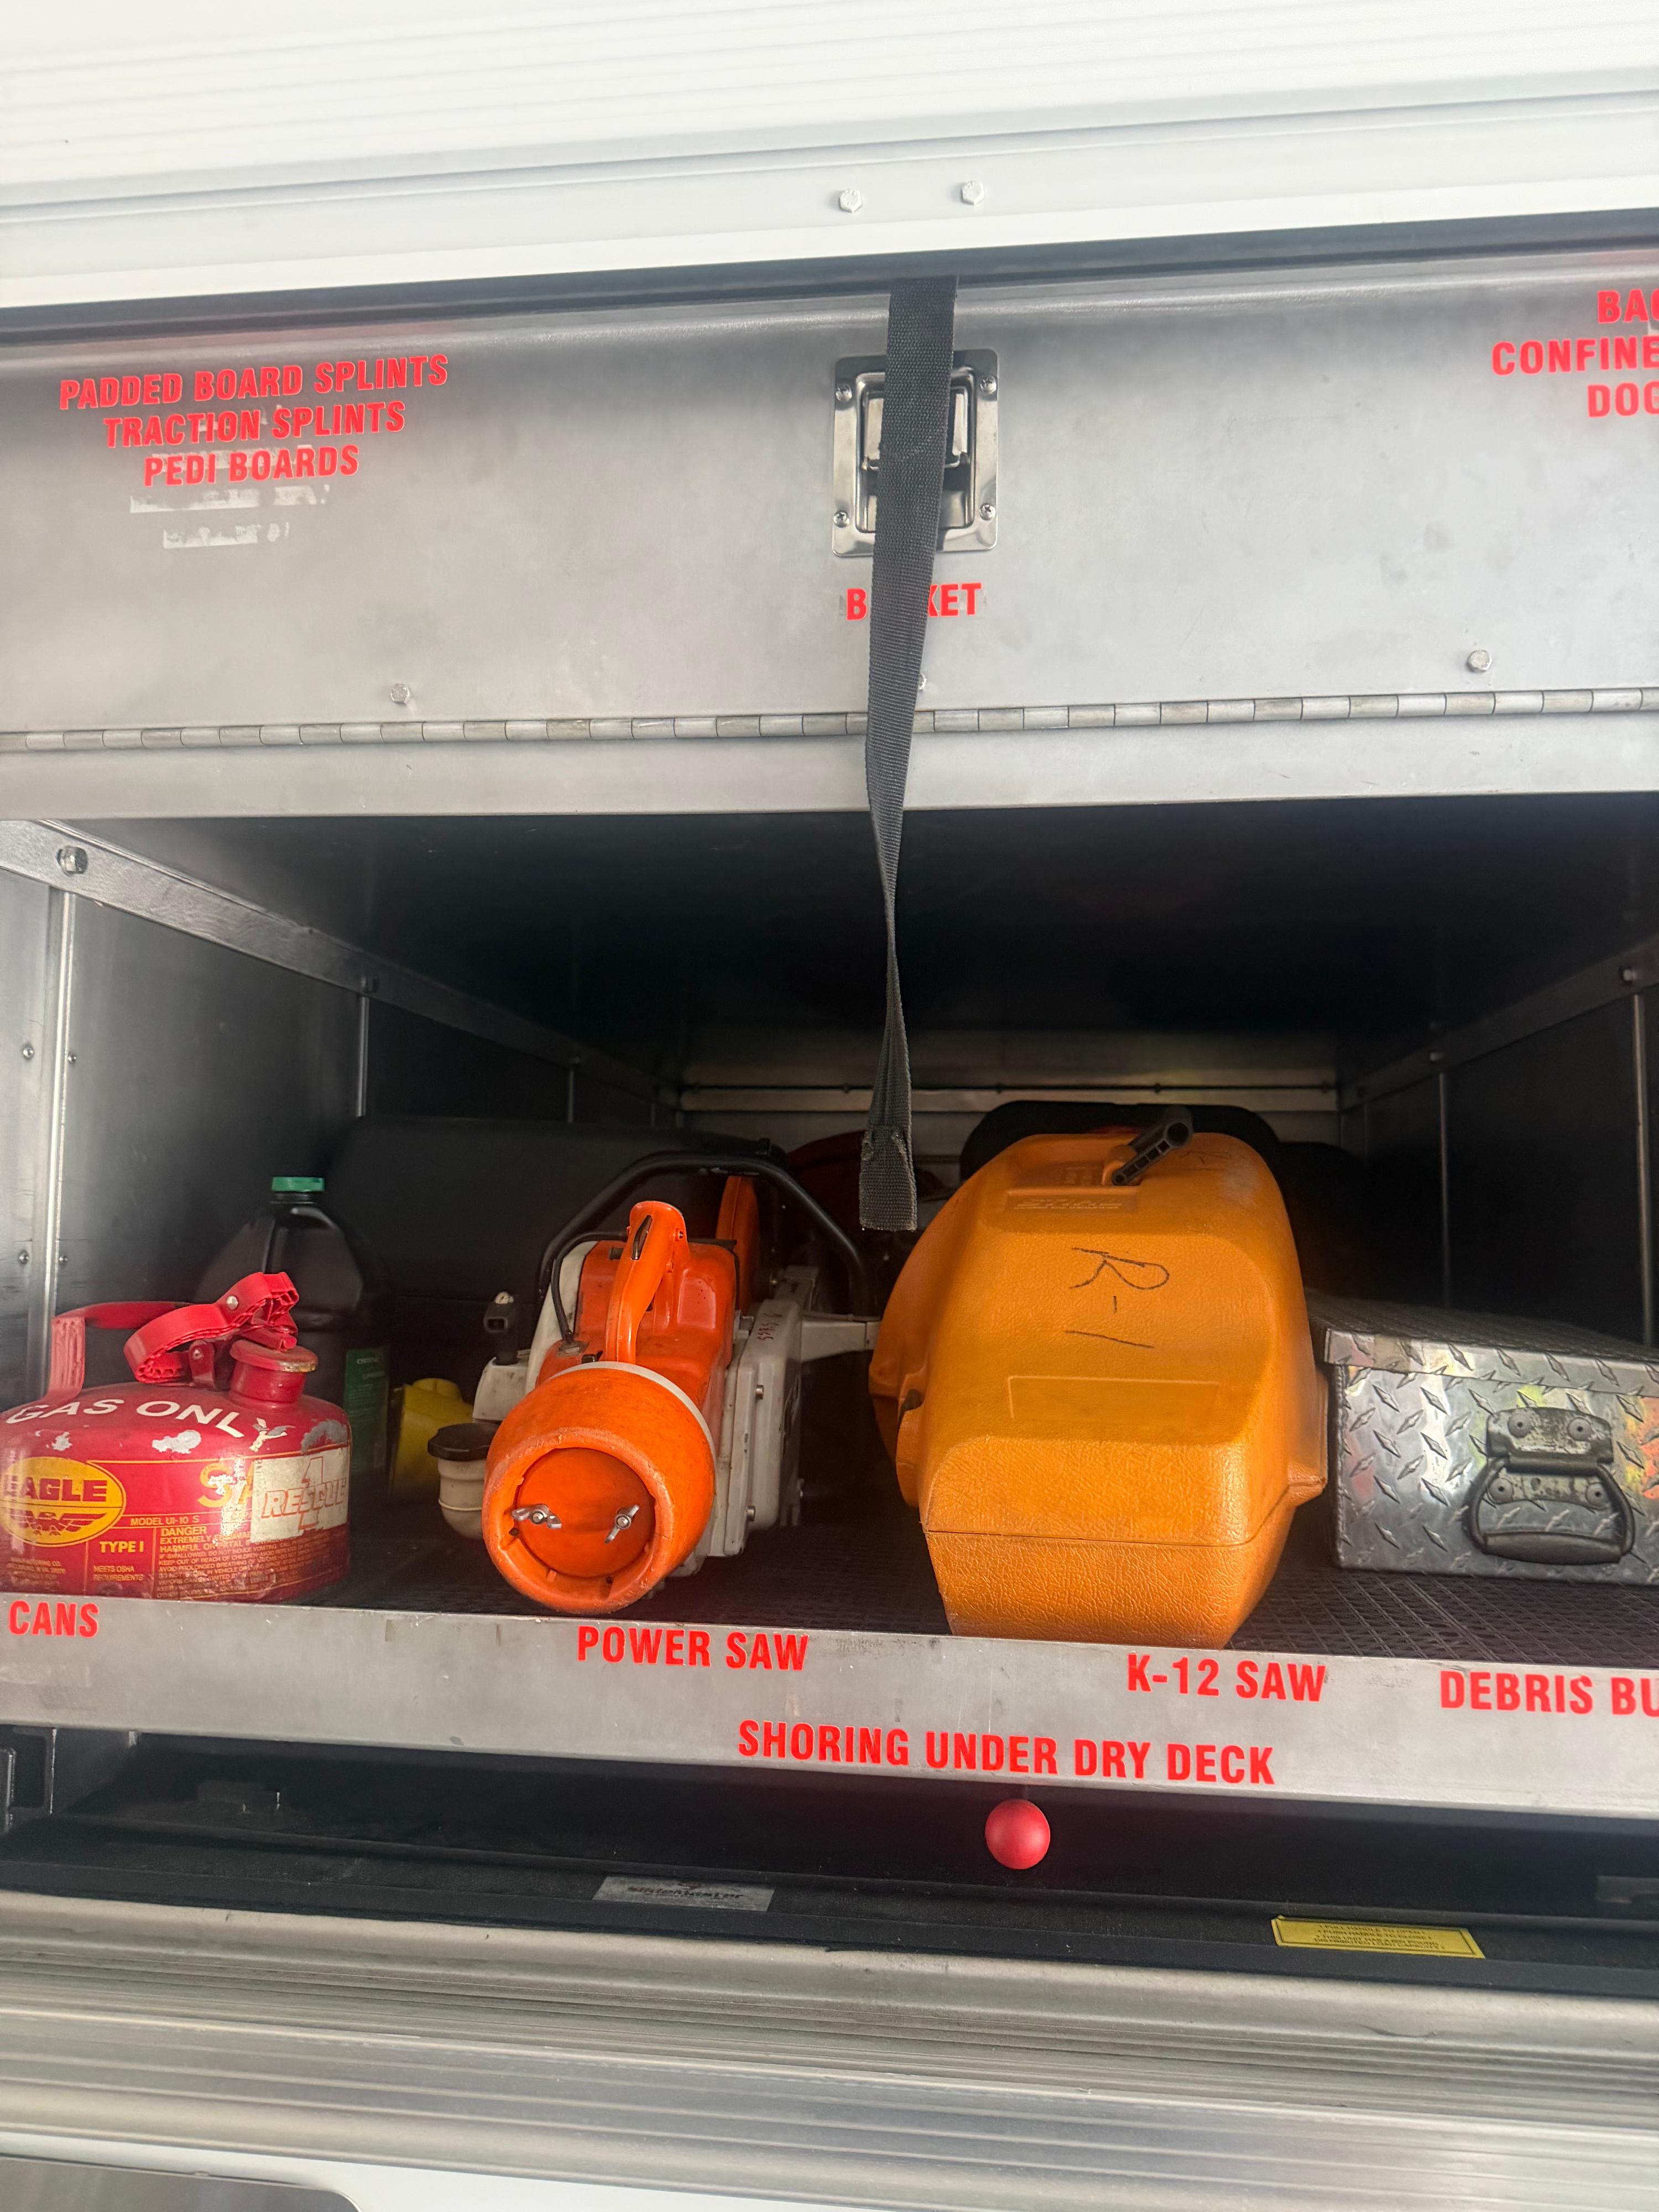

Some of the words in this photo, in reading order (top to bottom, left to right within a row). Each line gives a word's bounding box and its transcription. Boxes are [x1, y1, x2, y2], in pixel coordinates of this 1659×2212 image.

[1492, 335, 1659, 376] CONFINE
[60, 373, 182, 410] PADDED
[194, 365, 303, 401] BOARD
[314, 354, 448, 394] SPLINTS
[103, 409, 261, 448] TRACTION
[270, 400, 406, 440] SPLINTS
[144, 453, 217, 487] PEDI
[228, 444, 359, 483] BOARDS
[6, 1399, 124, 1425] GAS
[136, 1401, 293, 1452] ONLY
[131, 1517, 164, 1526] MODEL
[160, 1526, 207, 1537] DANGER
[160, 1535, 212, 1545] EXTREMELY
[100, 1541, 137, 1553] TYPE
[160, 1543, 201, 1554] HARMFUL
[8, 1600, 100, 1639] CANS
[577, 1625, 712, 1667] POWER
[725, 1631, 810, 1672] SAW
[1127, 1653, 1220, 1697] K-12
[1234, 1660, 1327, 1703] SAW
[1440, 1671, 1594, 1715] DEBRIS
[737, 1719, 909, 1766] SHORING
[925, 1731, 1058, 1775] UNDER
[1073, 1739, 1152, 1779] DRY
[1166, 1743, 1275, 1786] DECK
